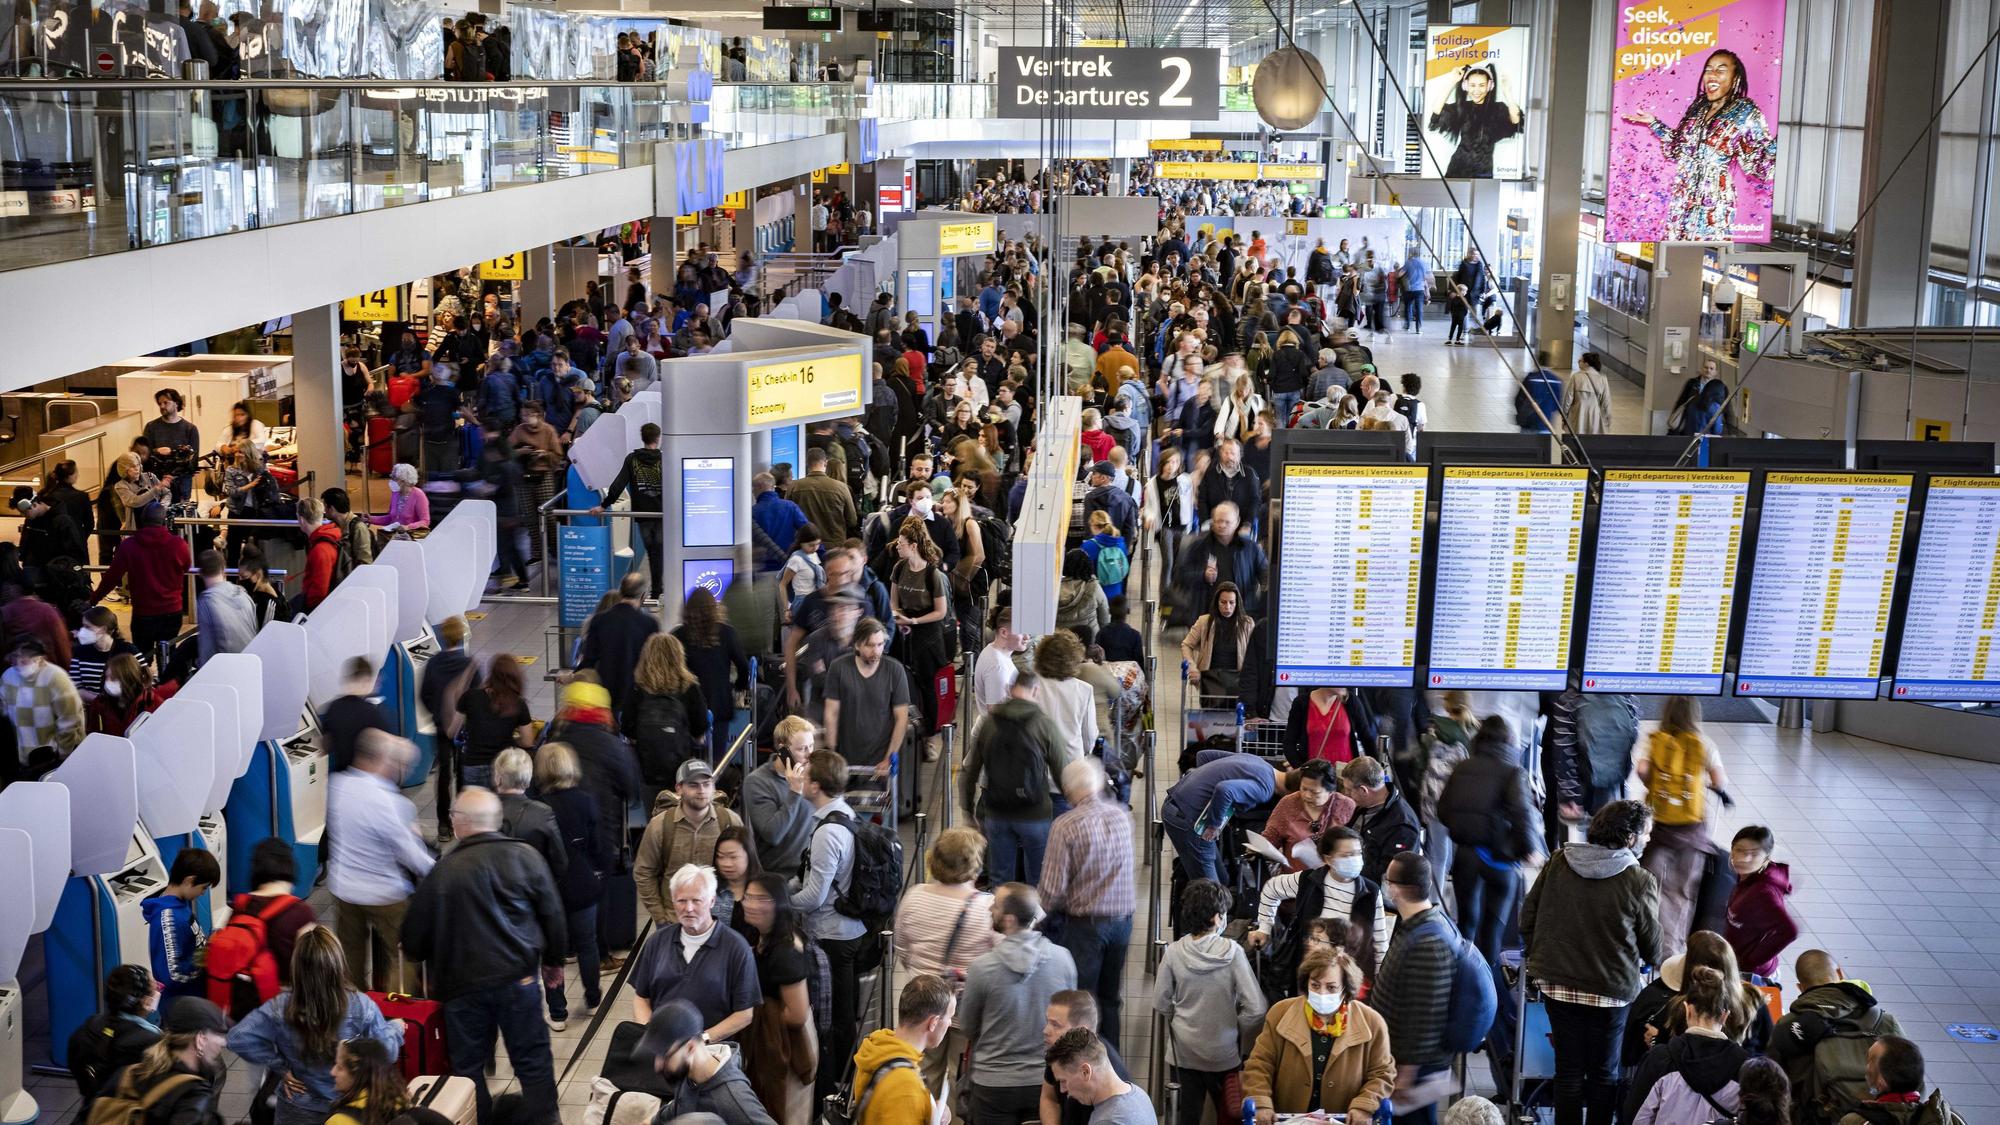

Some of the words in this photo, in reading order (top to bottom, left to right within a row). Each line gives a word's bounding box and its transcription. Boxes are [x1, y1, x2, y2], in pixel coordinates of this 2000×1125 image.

[1624, 6, 1674, 25] Seek,
[1432, 35, 1476, 47] Holiday
[1633, 27, 1716, 46] discover,
[1438, 48, 1478, 60] playlist
[1482, 49, 1500, 58] on!
[1622, 49, 1681, 70] enjoy!
[1017, 55, 1112, 76] Vertrek
[1159, 57, 1192, 106] 2
[965, 226, 980, 236] 12-15
[1730, 223, 1764, 232] Schiphol
[360, 289, 388, 308] 14
[765, 373, 797, 385] Check-in
[800, 366, 814, 384] 16
[751, 403, 785, 415] Economy
[1299, 468, 1321, 476] Flight
[1482, 470, 1524, 478] departures
[1642, 473, 1685, 481] departures
